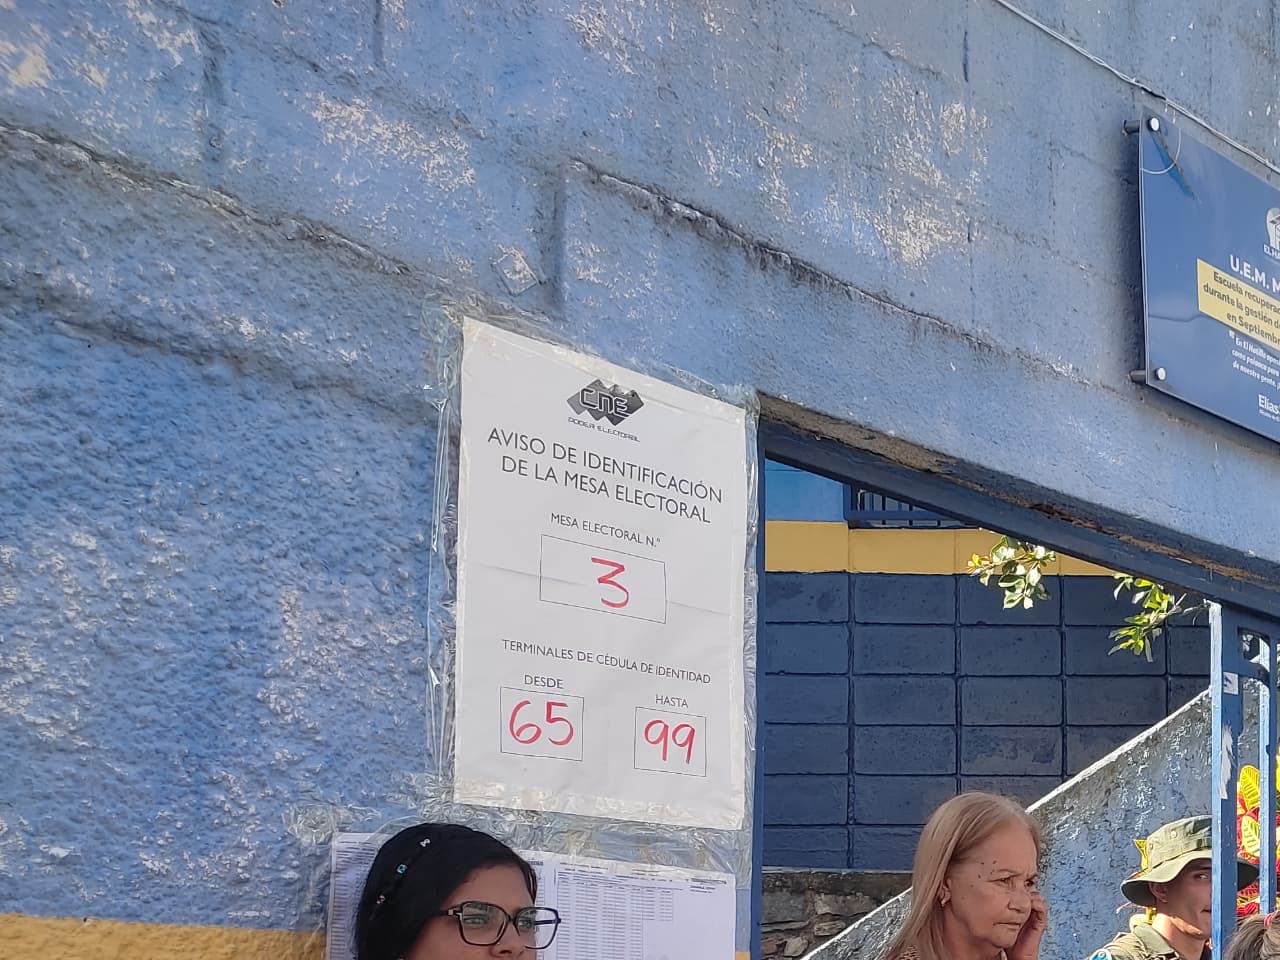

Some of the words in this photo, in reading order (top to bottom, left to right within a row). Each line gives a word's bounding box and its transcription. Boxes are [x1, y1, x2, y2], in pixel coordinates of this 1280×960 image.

[1213, 271, 1243, 296] Escuela
[1230, 255, 1270, 290] U.E.M.
[1203, 283, 1235, 305] durante
[1235, 299, 1244, 312] la
[1226, 312, 1237, 323] en
[580, 386, 630, 418] CNE
[487, 427, 546, 455] AVISO
[552, 443, 577, 464] DE
[583, 450, 723, 504] IDENTIFICACIÓN
[501, 455, 528, 477] DE
[534, 462, 558, 484] LA
[564, 470, 610, 498] MESA
[615, 484, 711, 524] ELECTORAL
[550, 512, 580, 529] MESA
[582, 521, 643, 545] ELECTORAL
[591, 556, 629, 609] 3
[501, 638, 574, 661] TERMINALES
[577, 651, 594, 663] DE
[596, 653, 638, 672] CÉDULA
[640, 662, 654, 675] DE
[655, 665, 712, 685] IDENTIDAD
[523, 674, 565, 690] DESDE
[654, 693, 689, 710] HASTA
[508, 700, 575, 747] 65
[643, 719, 696, 765] 99
